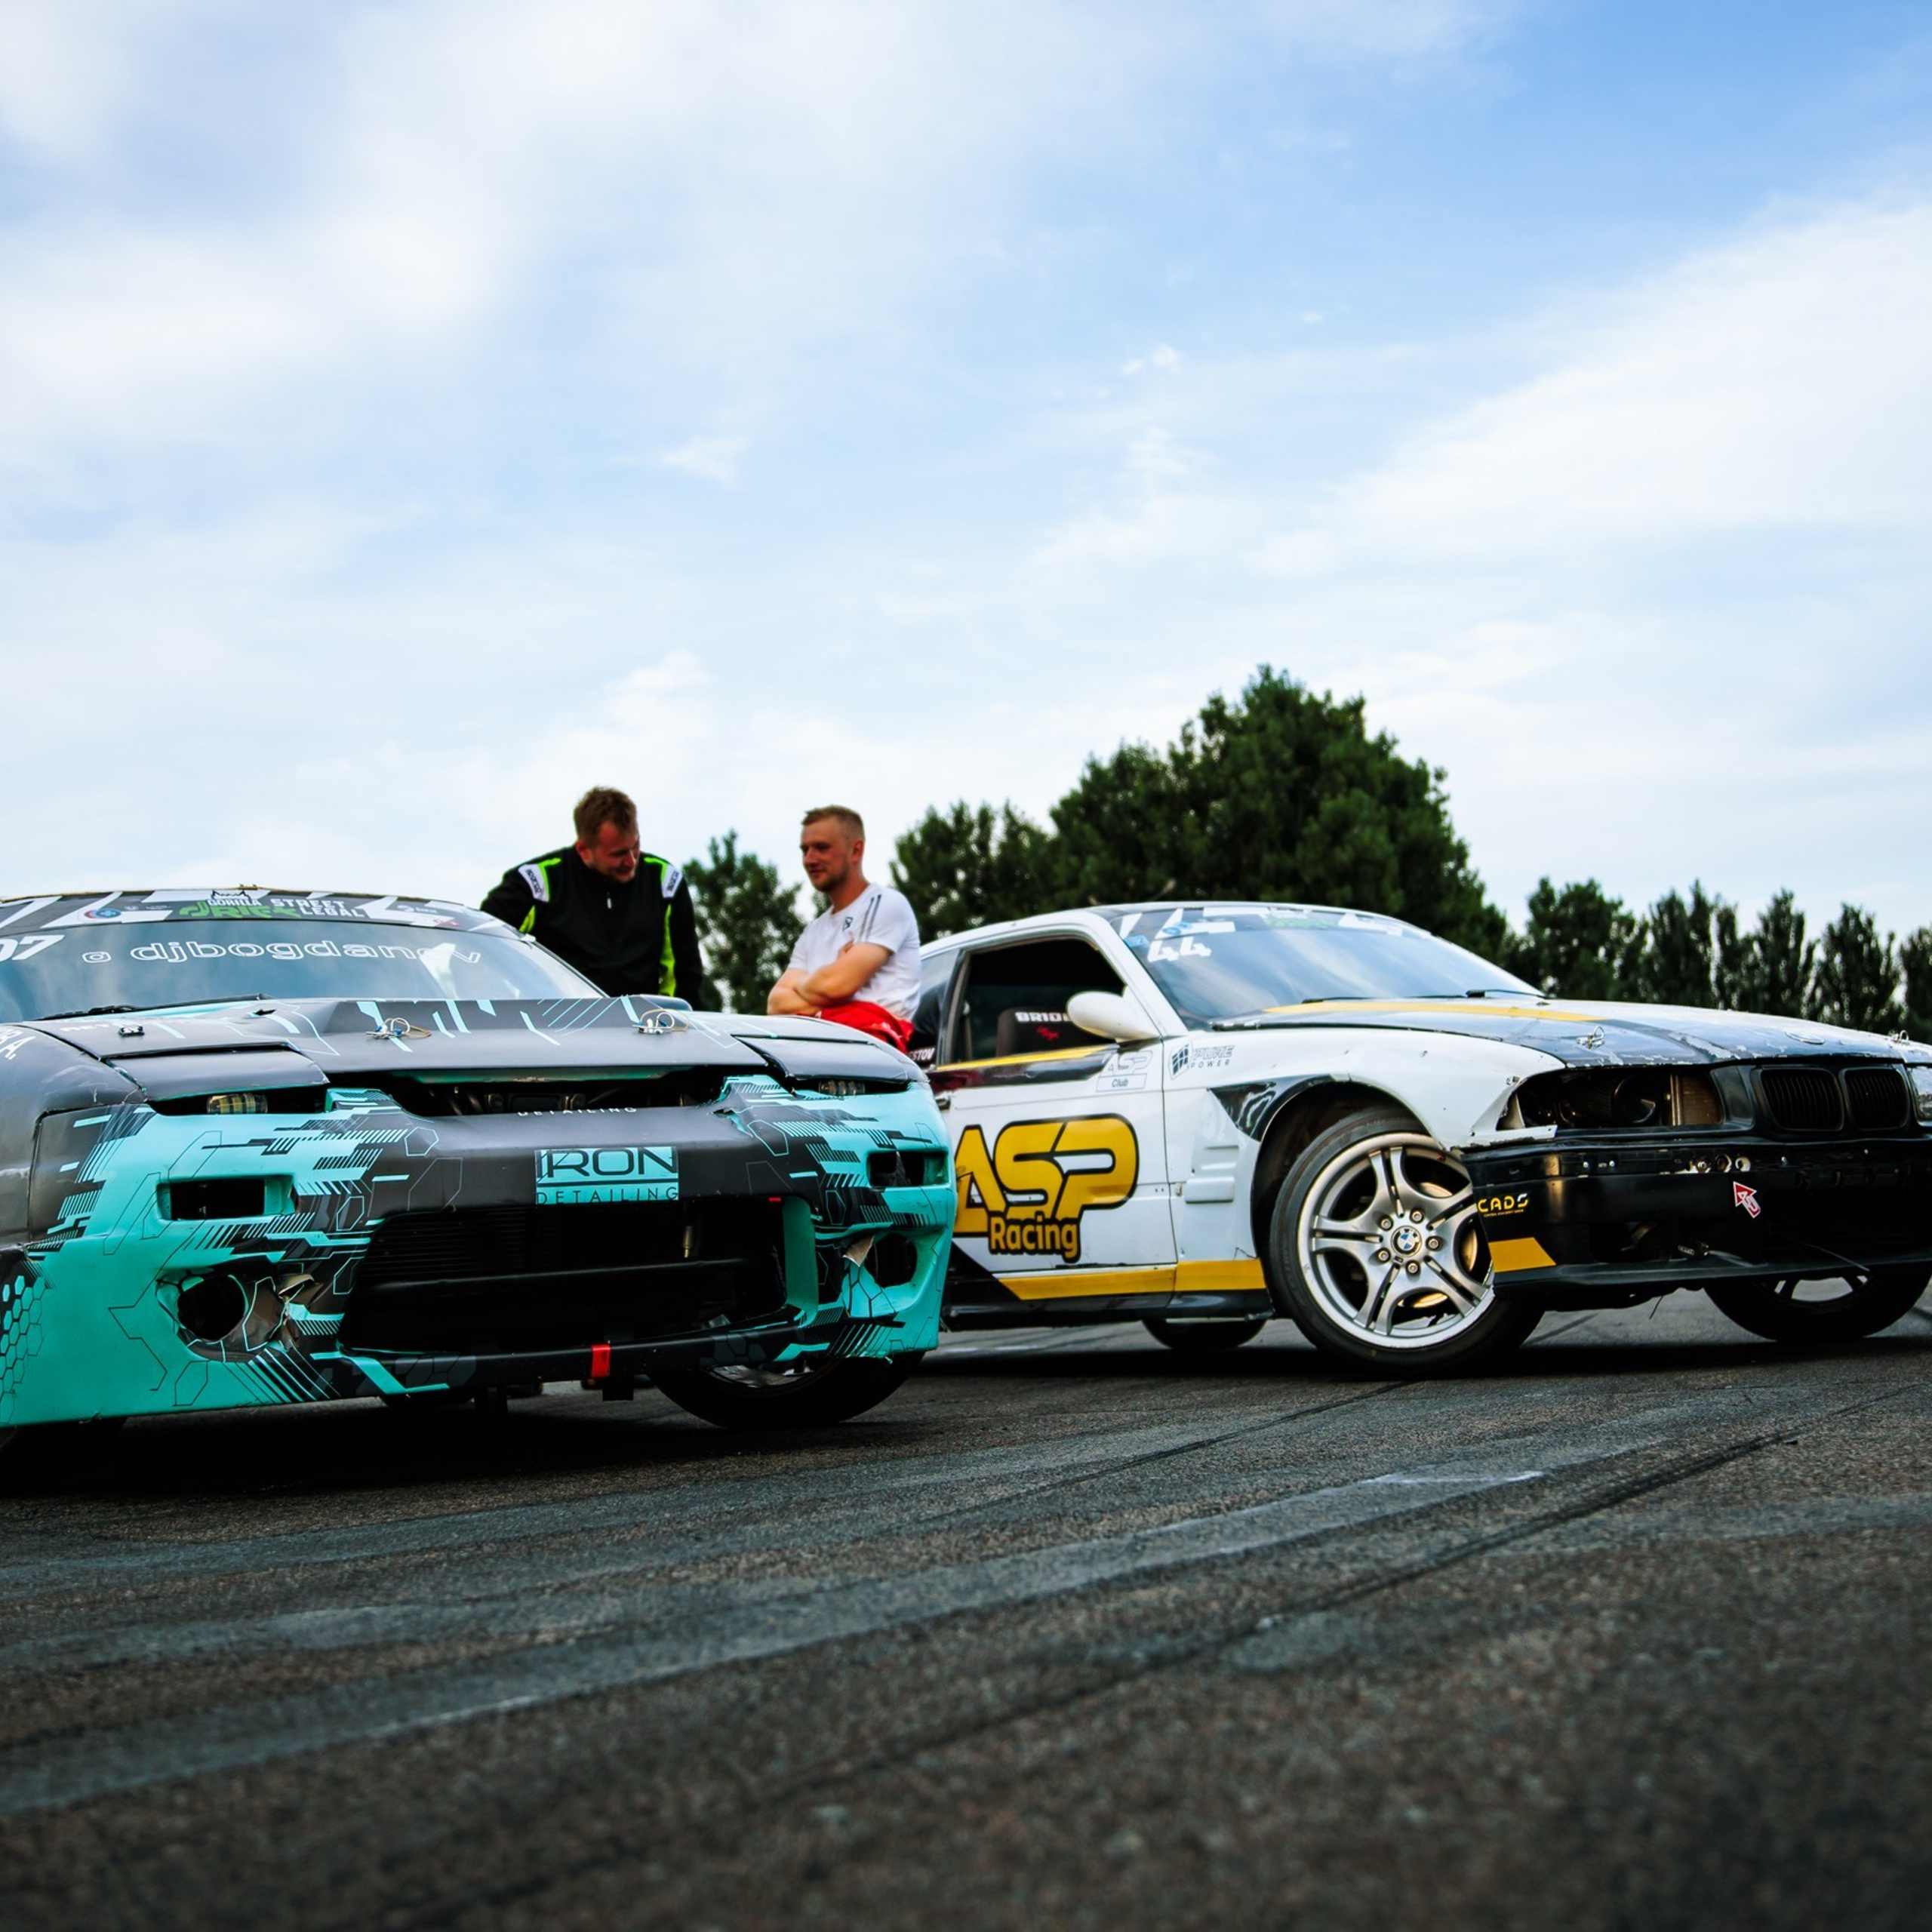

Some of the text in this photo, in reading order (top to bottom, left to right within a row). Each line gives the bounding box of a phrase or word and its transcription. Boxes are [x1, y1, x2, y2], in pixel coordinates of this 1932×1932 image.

[270, 898, 345, 909] STREET
[300, 906, 365, 917] LEGAL
[1112, 1078, 1129, 1088] Club
[537, 1147, 679, 1178] IRON
[953, 1112, 1139, 1238] ASP
[537, 1186, 678, 1204] DETAILING
[989, 1211, 1081, 1263] Racing
